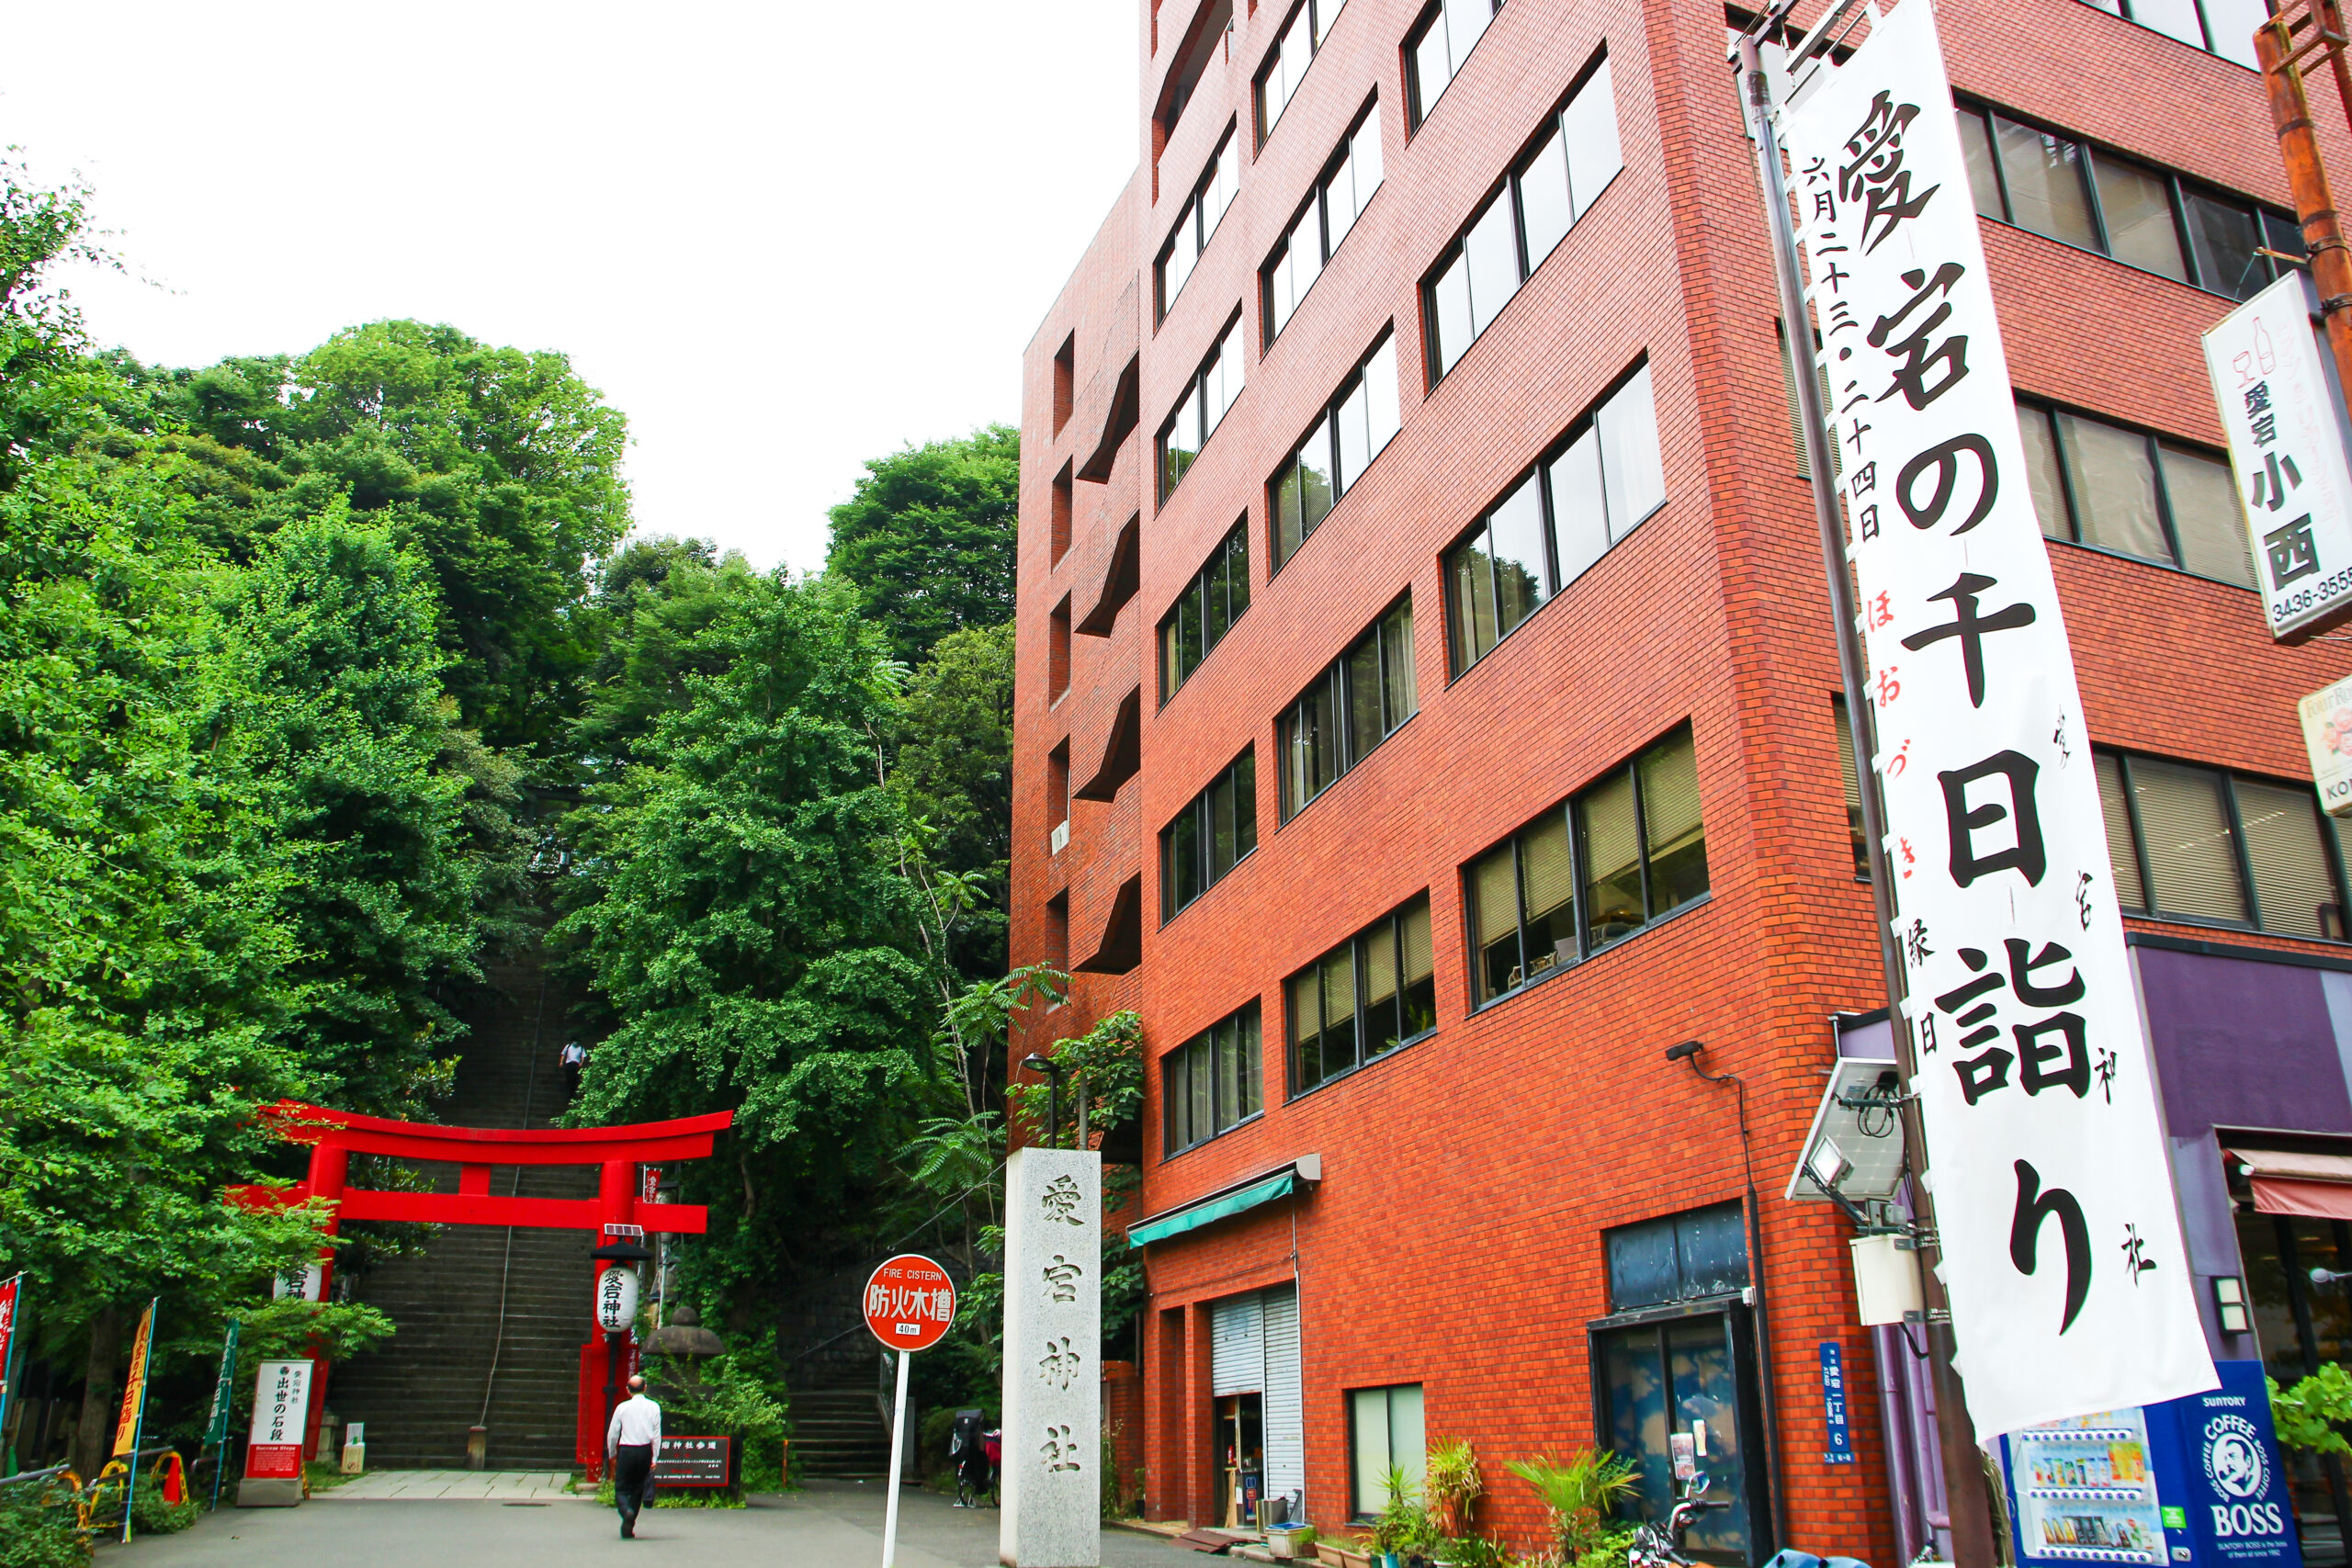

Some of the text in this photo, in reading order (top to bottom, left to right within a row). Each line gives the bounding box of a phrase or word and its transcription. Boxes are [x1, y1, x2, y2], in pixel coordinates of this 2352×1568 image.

[2244, 379, 2320, 592] 愛宕小西
[2273, 566, 2352, 623] 3436-3555
[1839, 90, 2092, 1336] 愛宕の千日詣り
[2306, 686, 2352, 718] Four Ro
[2326, 778, 2352, 801] KO
[883, 1268, 942, 1280] FIRE CISTERN
[603, 1270, 623, 1328] 愛宕神社
[868, 1284, 952, 1322] 防火水槽
[1039, 1174, 1084, 1473] 愛宕神社
[269, 1377, 289, 1441] 出世の石段
[2202, 1397, 2246, 1407] SUNTORY
[1834, 1432, 1843, 1446] 6
[2204, 1415, 2256, 1440] COFFEE
[2211, 1504, 2284, 1537] BOSS
